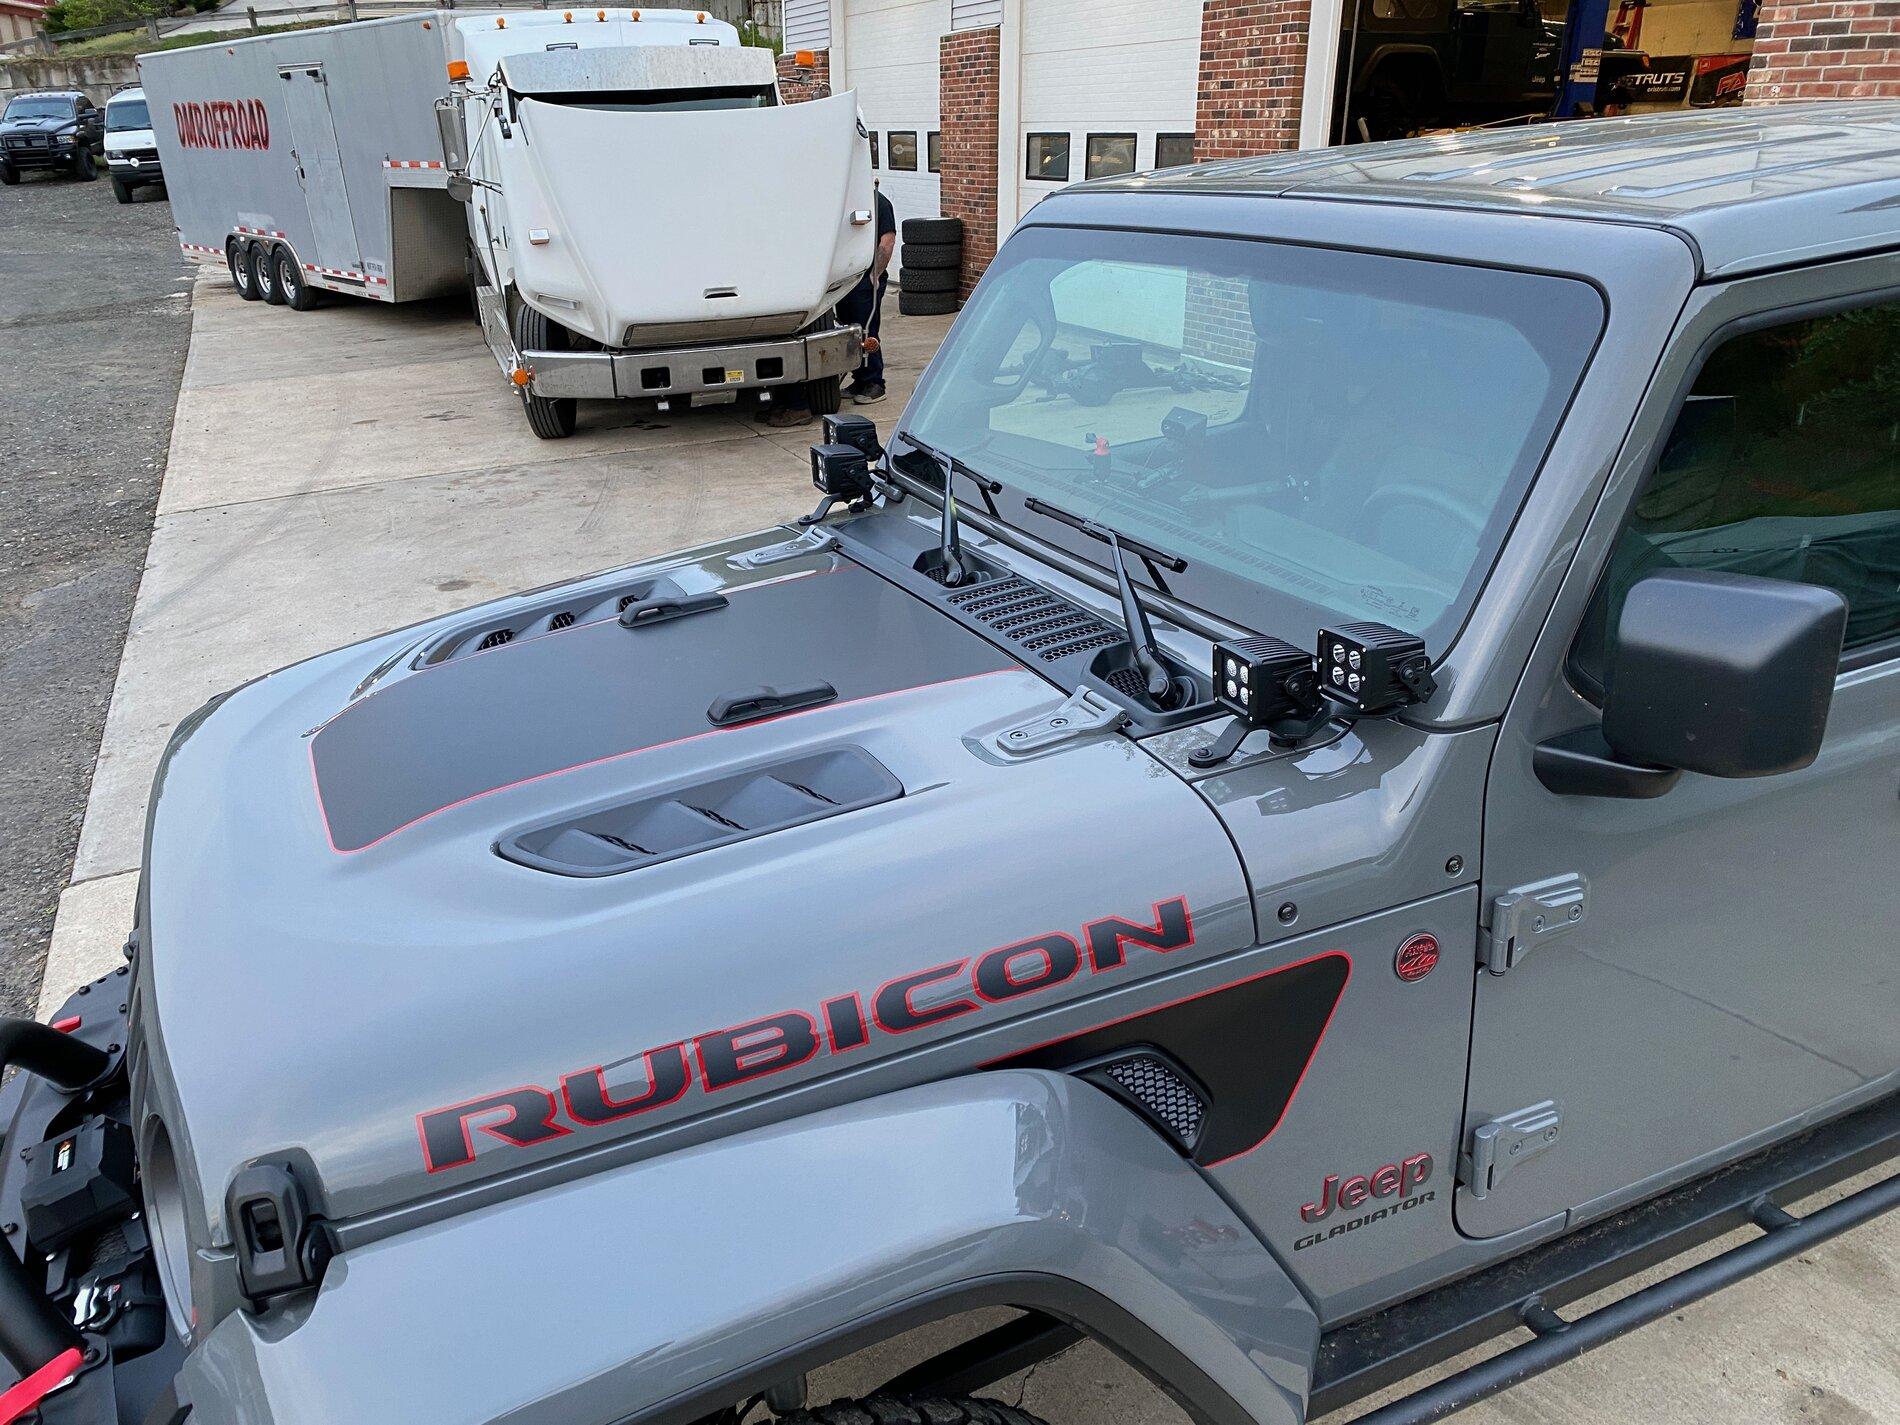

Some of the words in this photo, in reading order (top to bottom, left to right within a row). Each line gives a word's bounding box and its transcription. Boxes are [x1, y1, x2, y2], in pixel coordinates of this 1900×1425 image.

[173, 99, 270, 151] DMROFFROAD
[416, 895, 1195, 1174] RUBICON
[1300, 1152, 1433, 1223] Jeep
[1293, 1191, 1436, 1251] GLADIATOR
